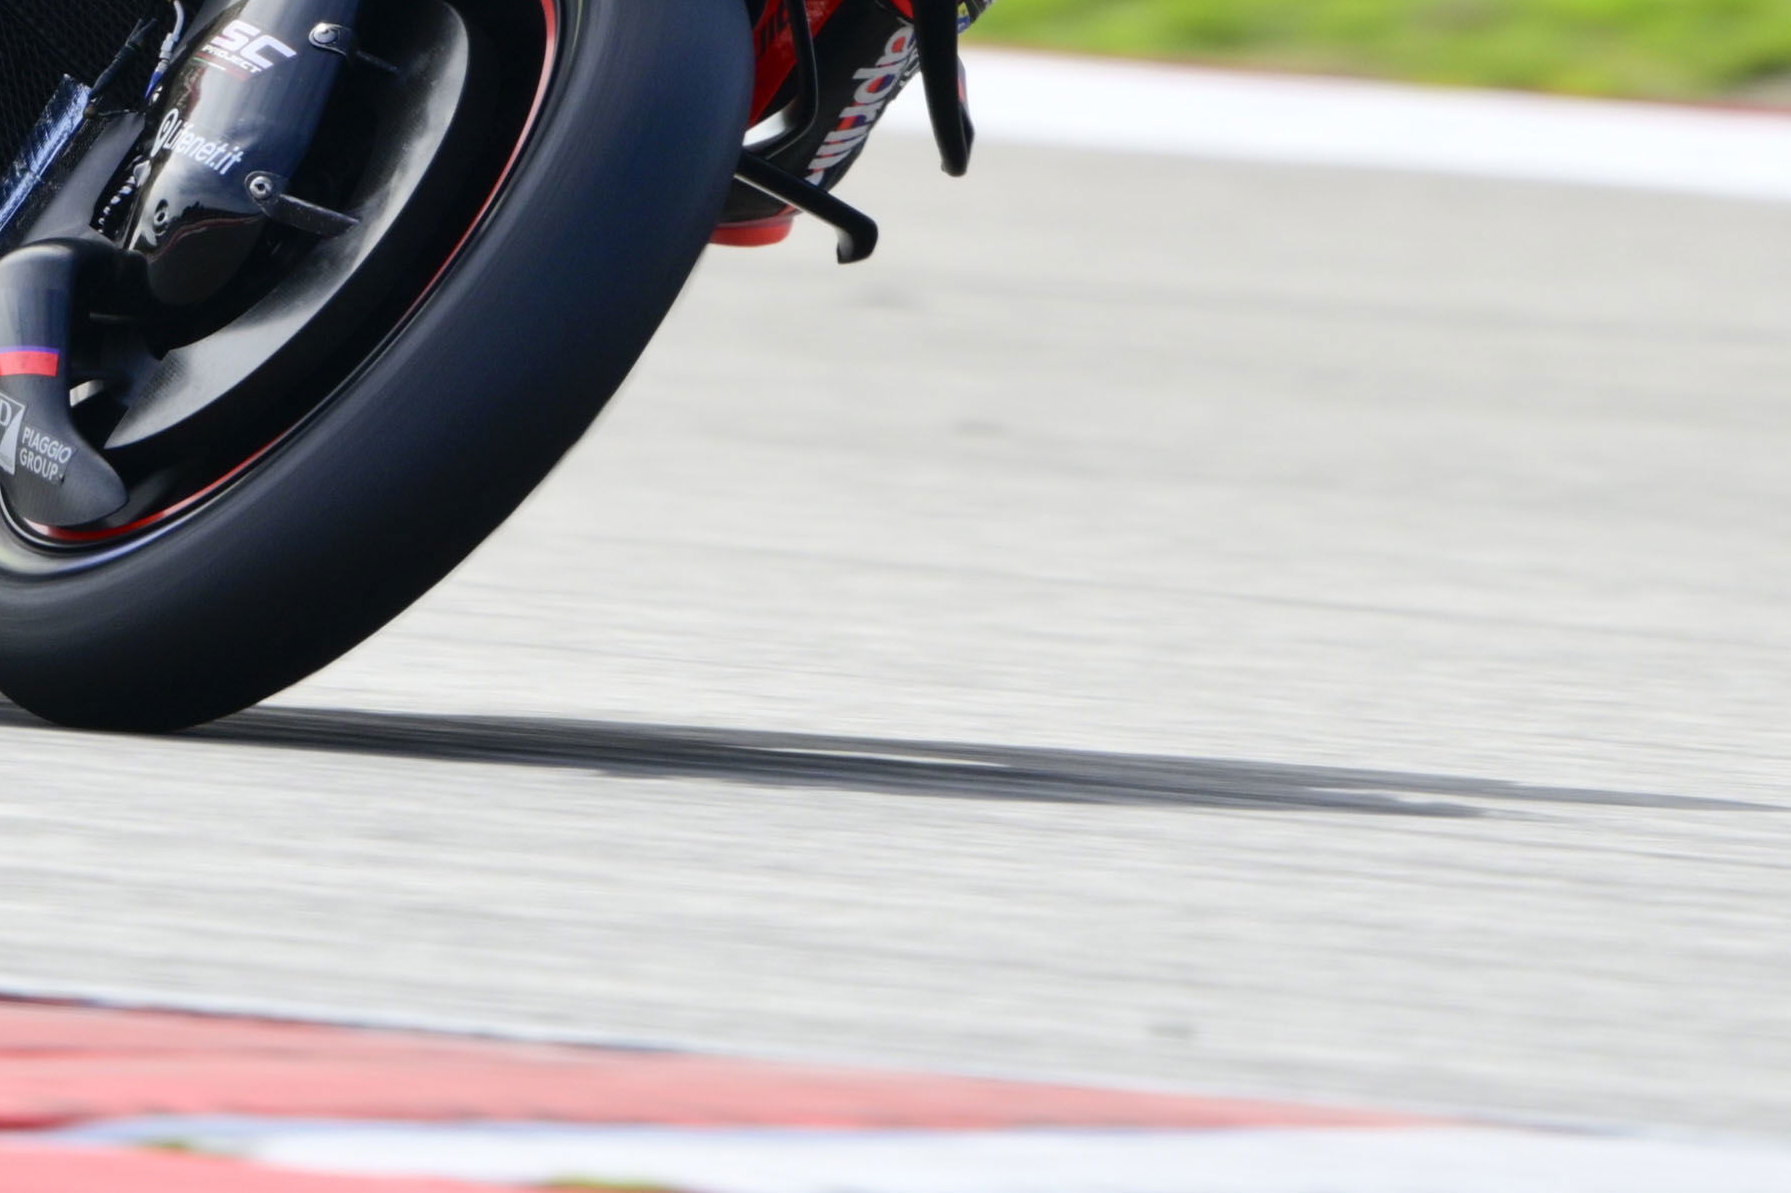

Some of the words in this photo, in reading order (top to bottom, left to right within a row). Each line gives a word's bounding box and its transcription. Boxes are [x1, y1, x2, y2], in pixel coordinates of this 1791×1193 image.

[201, 44, 262, 73] PROJECT
[211, 19, 297, 69] SC
[804, 24, 917, 186] aprili
[163, 119, 244, 174] Lifenet.it
[20, 448, 58, 481] GROUP
[22, 427, 72, 463] PIAGGIO
